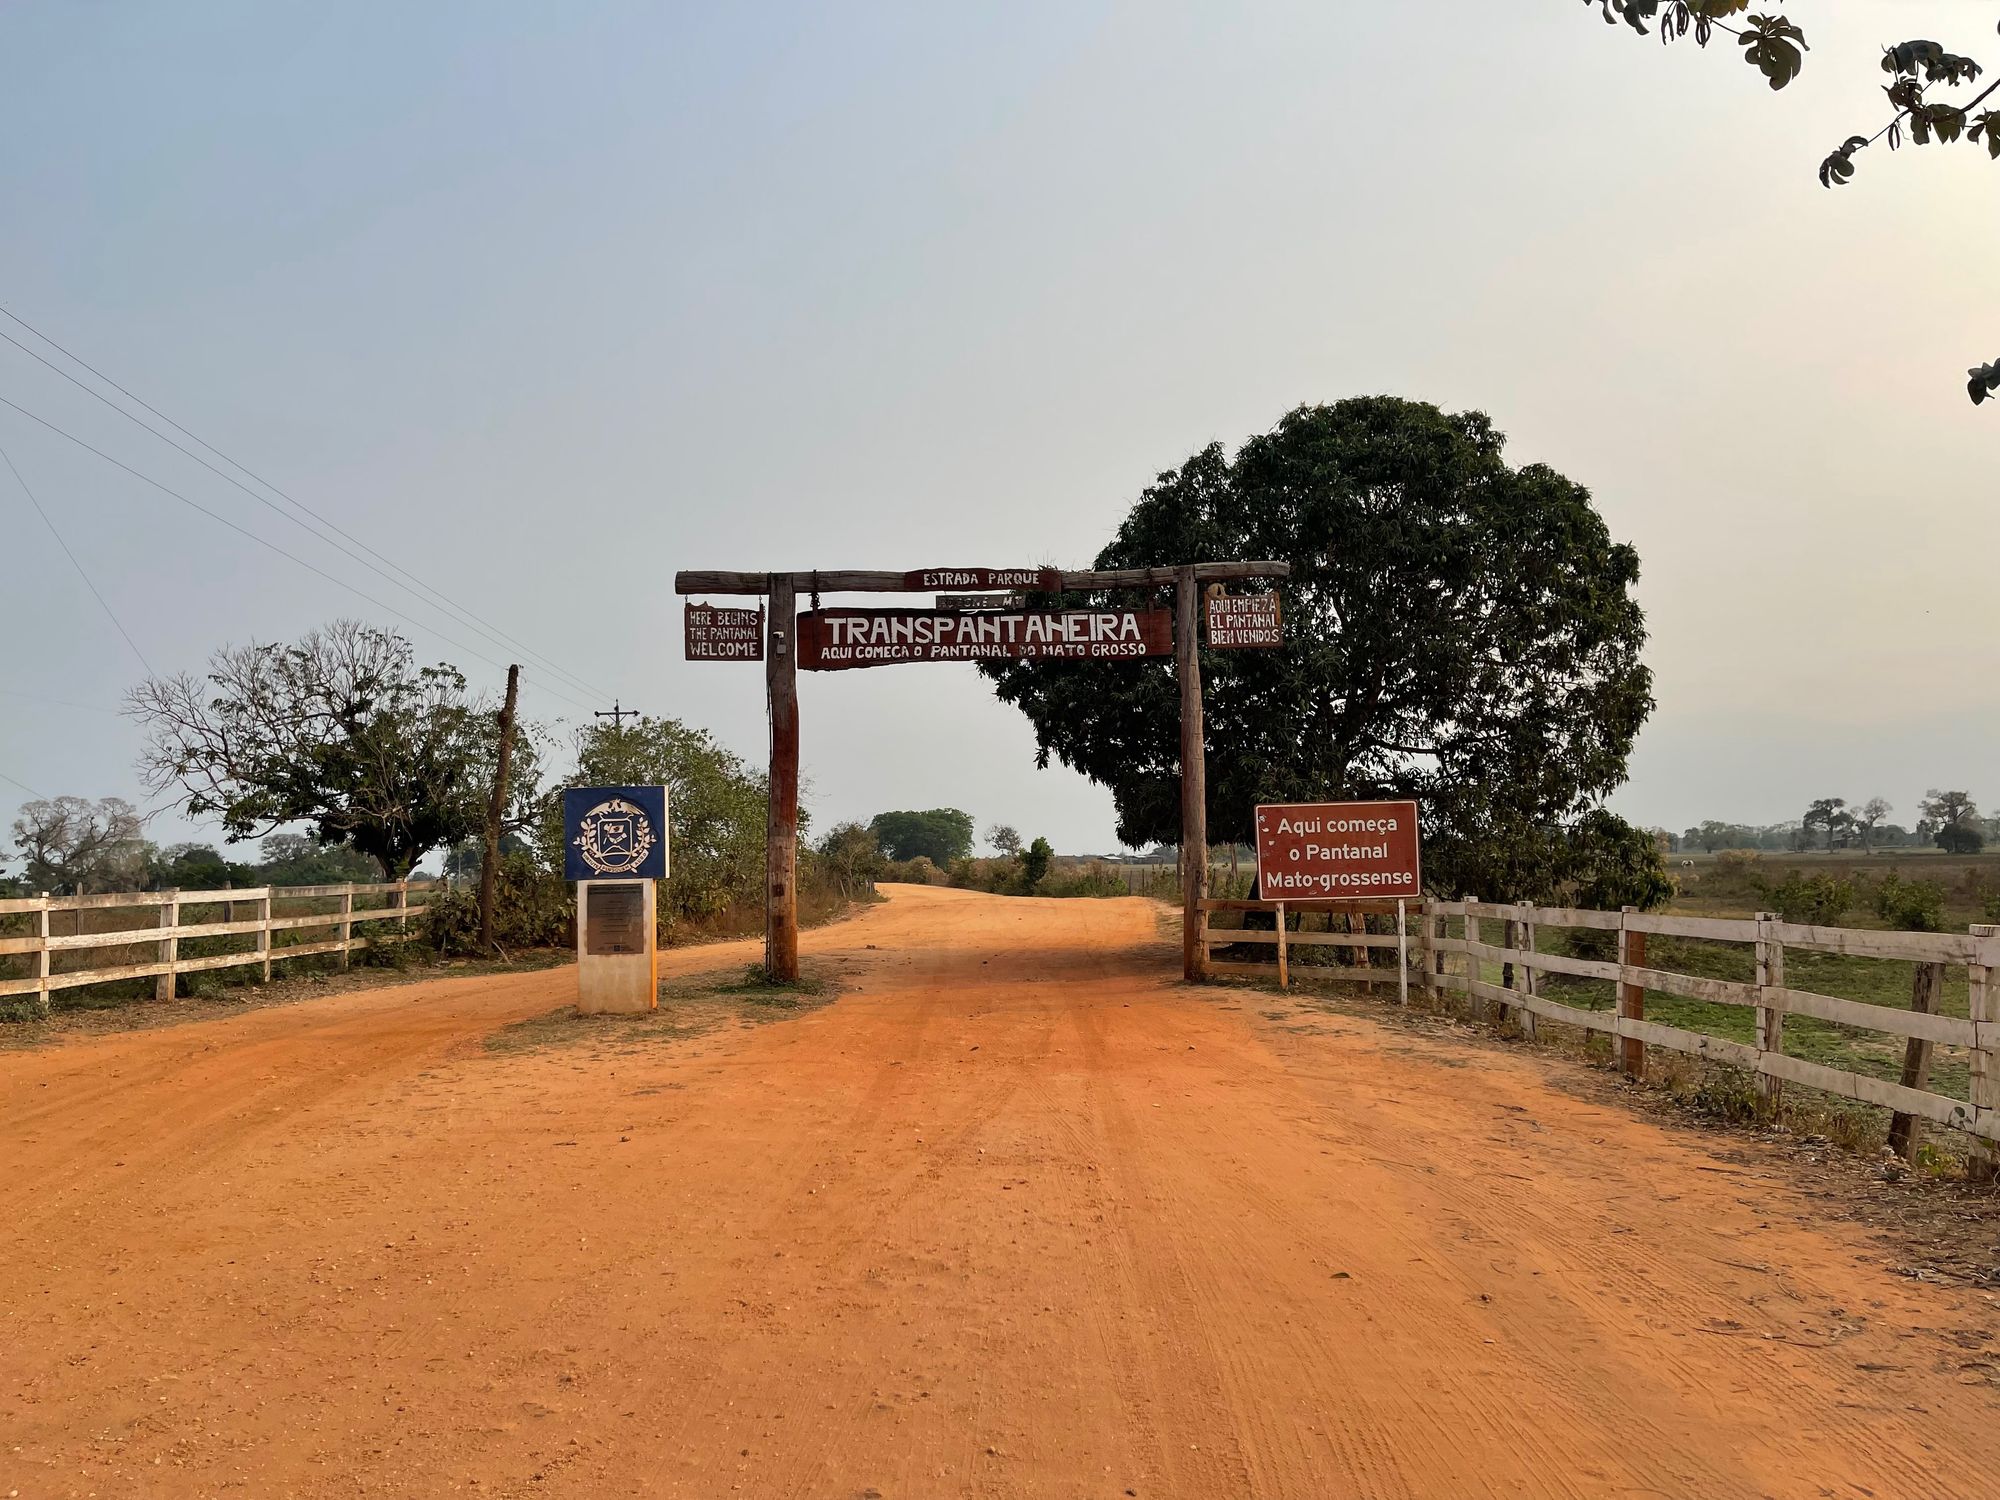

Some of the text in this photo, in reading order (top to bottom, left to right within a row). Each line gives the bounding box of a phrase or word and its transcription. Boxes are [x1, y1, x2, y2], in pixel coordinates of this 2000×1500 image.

[923, 572, 1040, 586] ESTRADA PARQUE
[1209, 598, 1277, 614] AQUI EMPIEZA
[689, 611, 758, 626] HERE BEGINS
[1210, 613, 1278, 629] EL PANTANAL
[690, 627, 759, 640] THE PANTANAL
[824, 613, 1142, 645] TRANSPANTANEIRA
[1211, 628, 1280, 645] BIEN VENIDOS
[689, 642, 758, 657] WELCOME
[821, 646, 852, 660] AQUI
[913, 646, 922, 657] O
[930, 644, 1012, 658] PANTANAL
[1042, 644, 1086, 657] MATO
[1091, 643, 1147, 657] GROSSO
[1277, 816, 1398, 838] Aqui começa
[1289, 842, 1388, 862] o Pantanal
[1266, 871, 1413, 892] Mato-grossense
